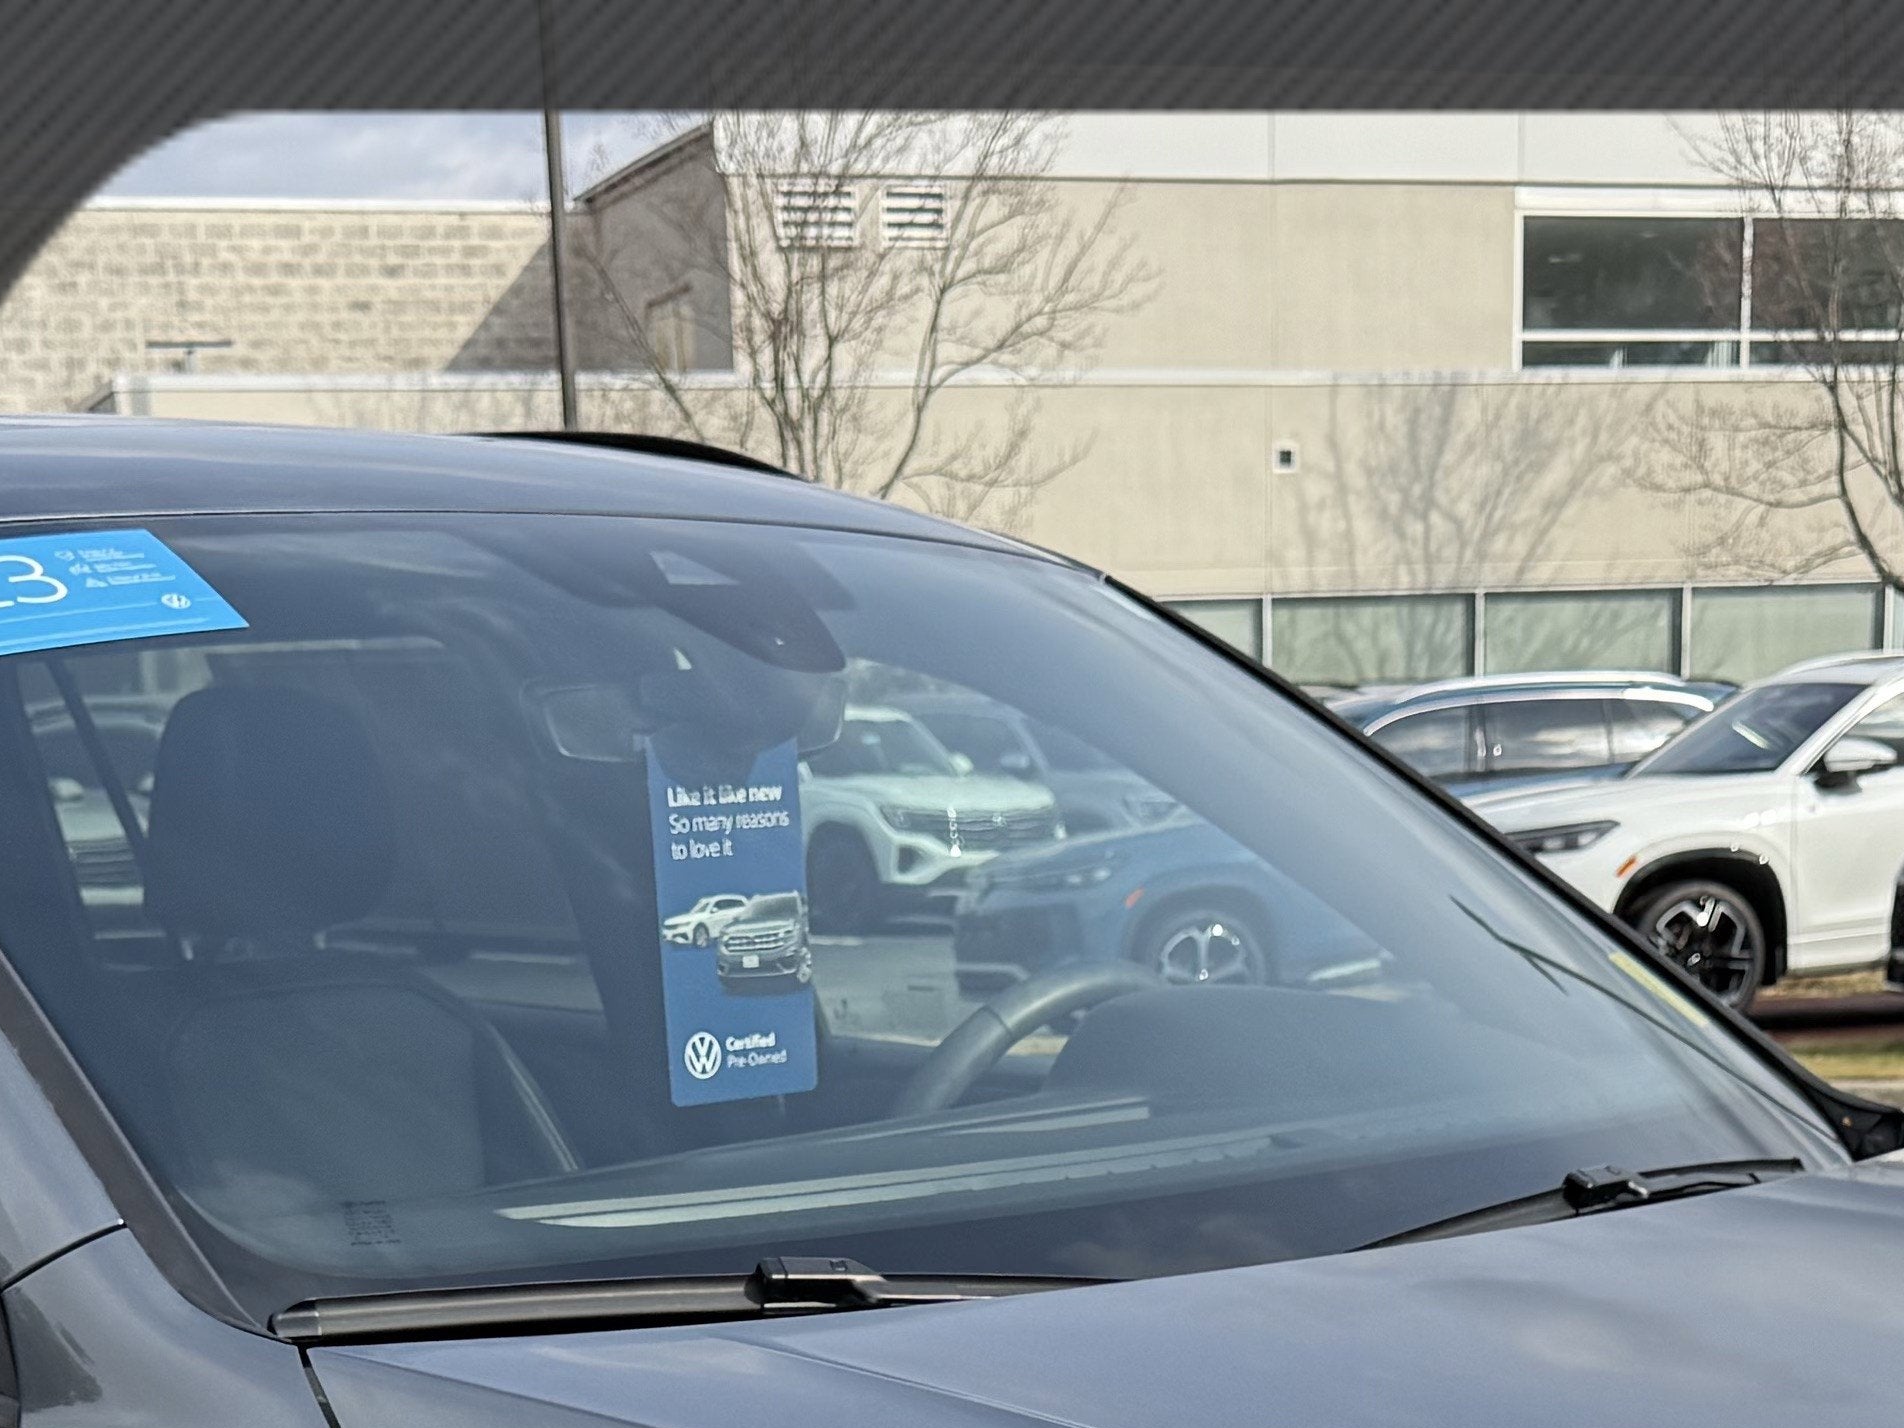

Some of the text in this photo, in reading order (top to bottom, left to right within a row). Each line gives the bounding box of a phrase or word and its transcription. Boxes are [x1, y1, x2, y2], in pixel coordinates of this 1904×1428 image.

[667, 786, 701, 808] Like
[749, 786, 782, 802] new
[668, 811, 790, 835] So many reasons
[671, 842, 688, 860] to
[689, 839, 720, 859] love
[725, 1031, 776, 1052] Certified
